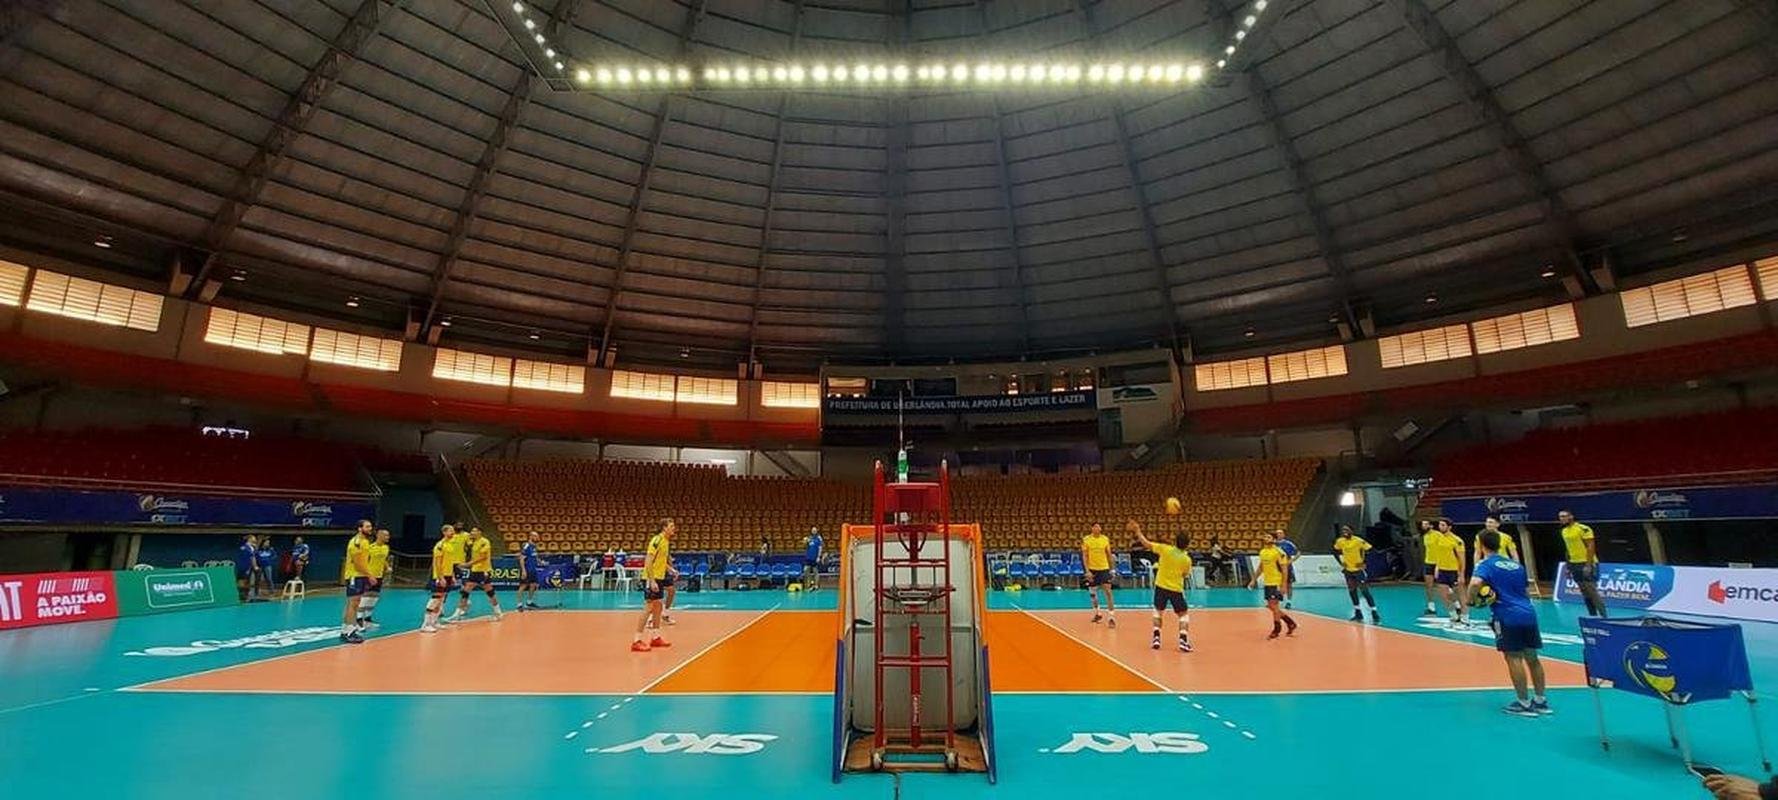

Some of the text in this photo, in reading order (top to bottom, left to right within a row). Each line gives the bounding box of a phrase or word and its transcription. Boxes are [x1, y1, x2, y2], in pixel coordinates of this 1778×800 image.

[38, 591, 106, 607] A PAIXÃO
[38, 604, 86, 618] MOVE.
[600, 732, 779, 754] SKY
[1053, 732, 1208, 753] SKY
